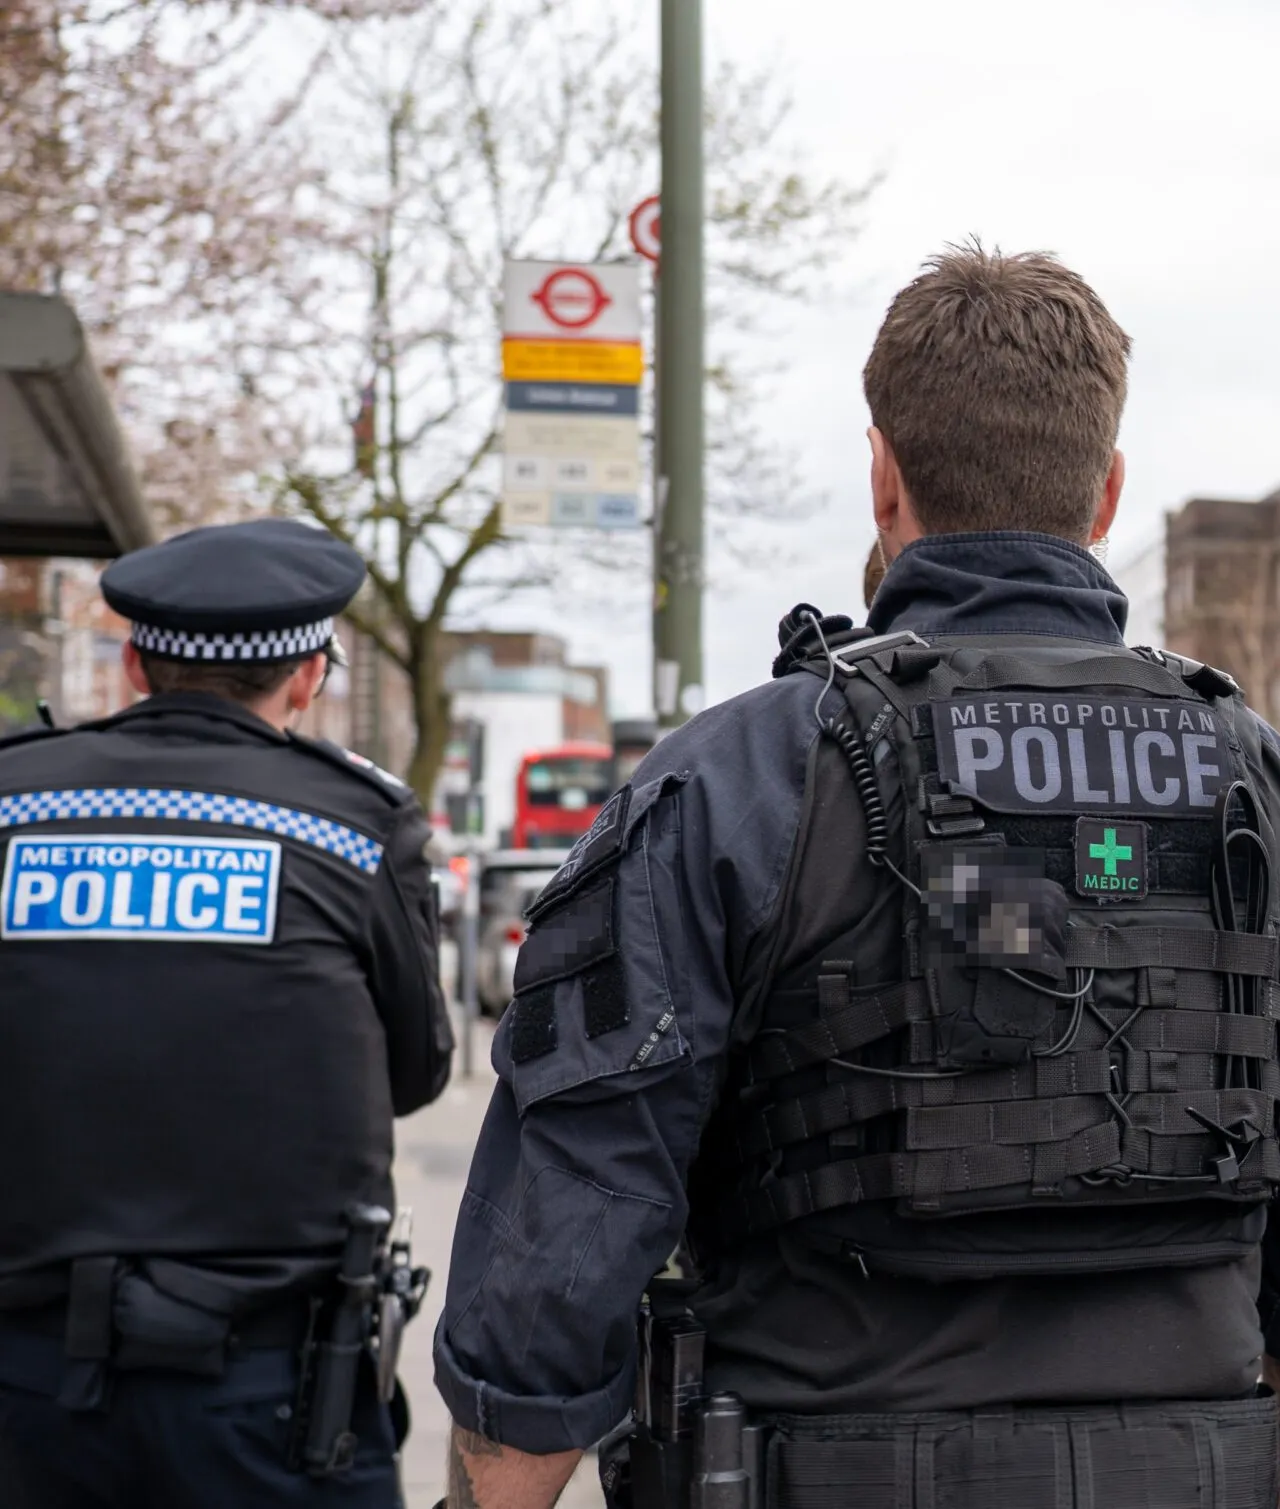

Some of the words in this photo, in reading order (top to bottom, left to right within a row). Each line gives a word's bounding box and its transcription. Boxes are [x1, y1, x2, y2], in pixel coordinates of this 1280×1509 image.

[950, 702, 1217, 733] METROPOLITAN
[953, 726, 1220, 807] POLICE
[20, 846, 267, 872] METROPOLITAN
[1084, 874, 1140, 890] MEDIC
[12, 870, 264, 931] POLICE
